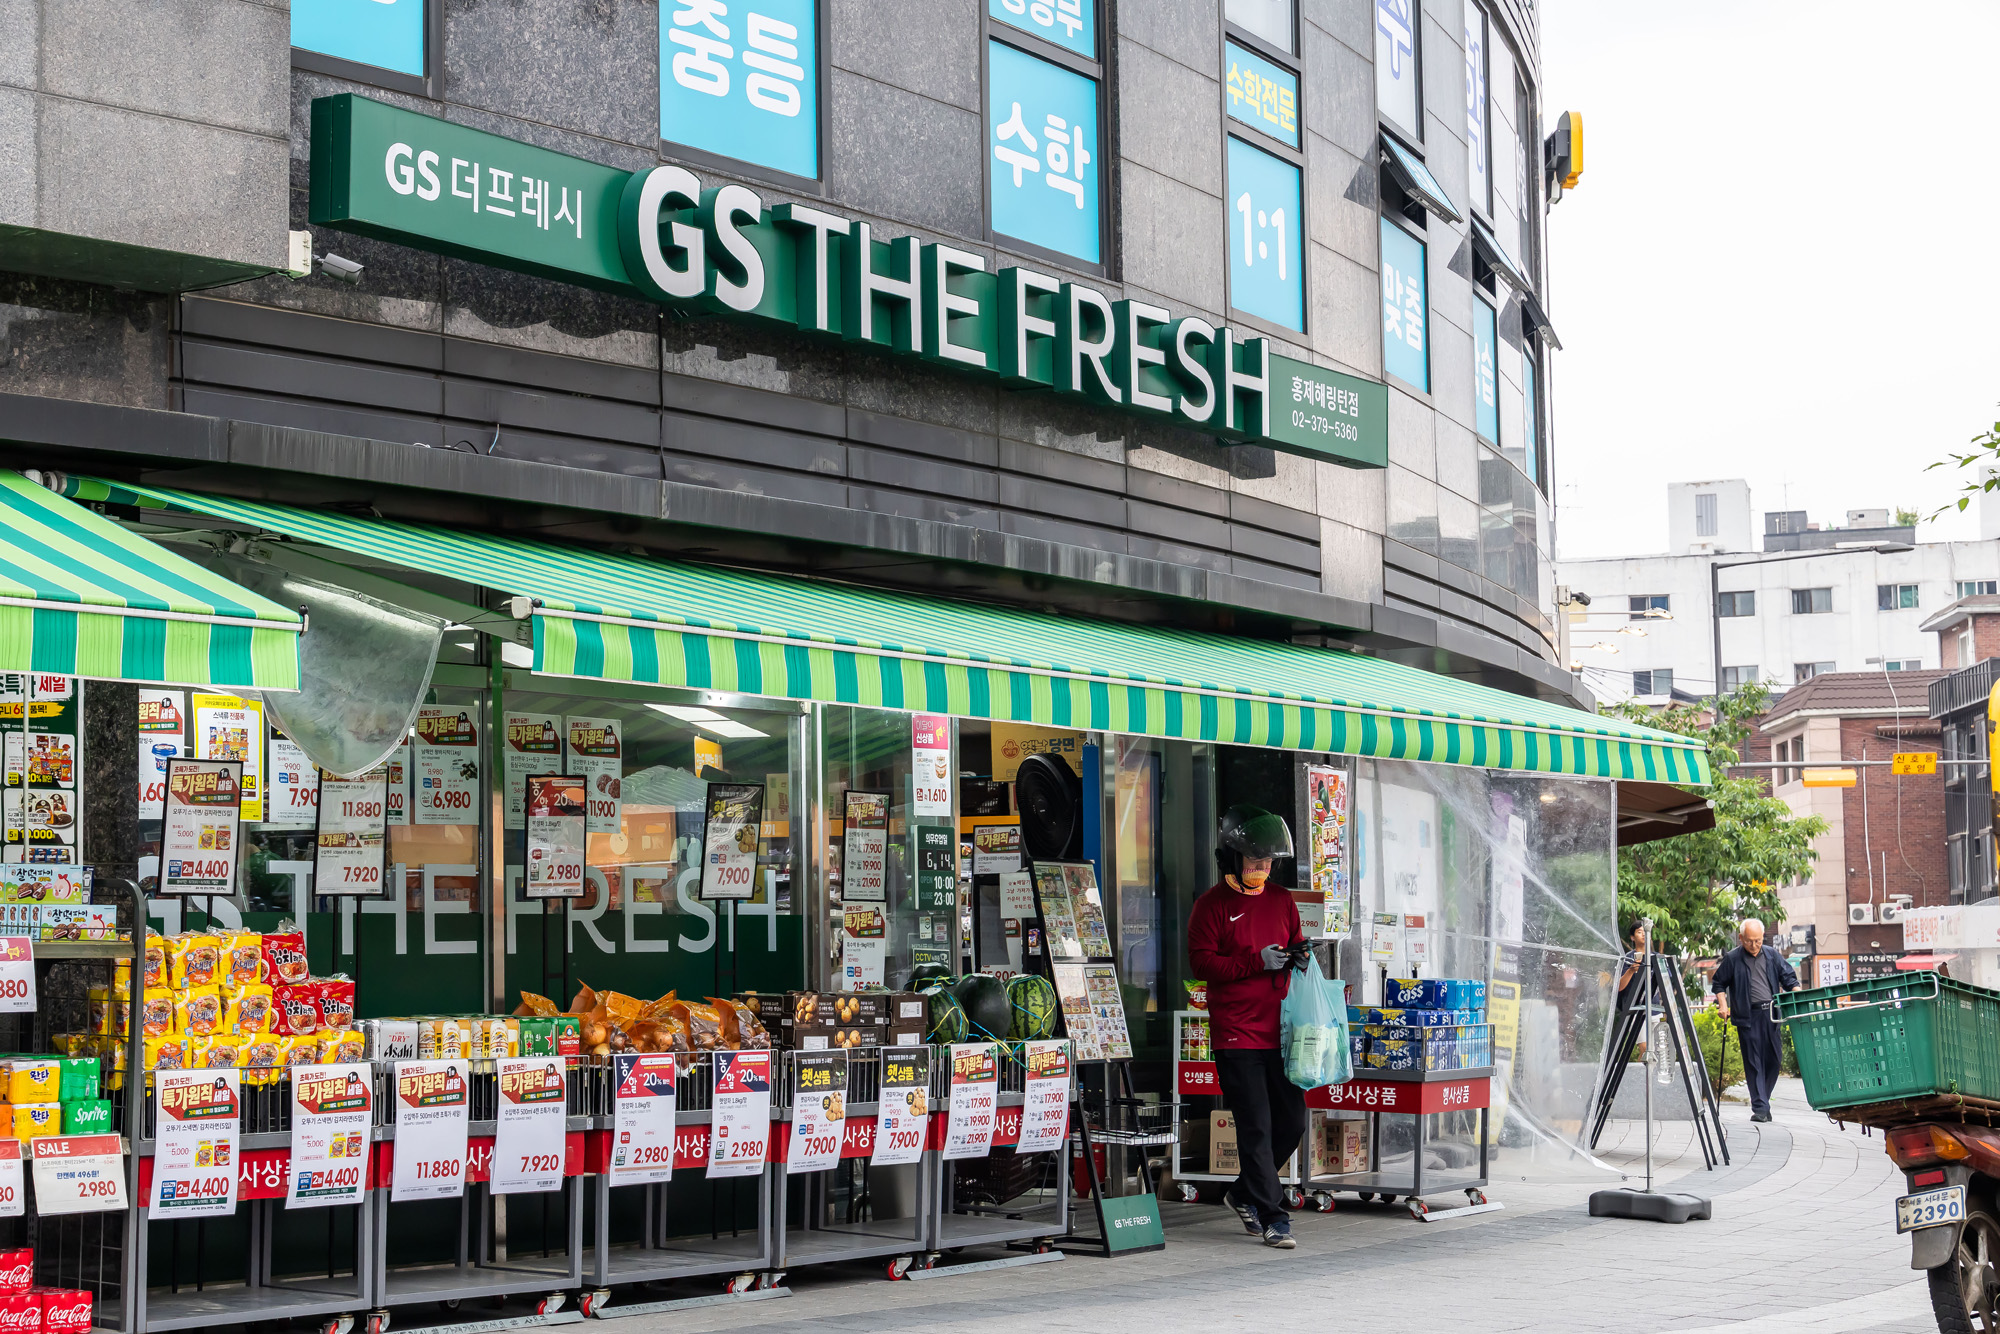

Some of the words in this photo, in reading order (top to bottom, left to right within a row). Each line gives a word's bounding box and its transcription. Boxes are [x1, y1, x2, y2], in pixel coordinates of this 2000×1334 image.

[669, 0, 804, 117] 중등
[1226, 61, 1295, 133] 수학전문
[994, 101, 1090, 210] 수학
[384, 142, 441, 201] GS
[451, 156, 583, 239] 더프레시
[1237, 192, 1287, 281] 1:1
[637, 164, 766, 312] GS
[791, 203, 987, 368] THE
[1016, 266, 1270, 437] FRESH
[1383, 262, 1424, 352] 맞춤
[1291, 375, 1359, 418] 홍제해링턴점
[1292, 409, 1358, 442] 02-379-5360
[39, 675, 66, 692] 세일
[418, 716, 458, 737] 특가원칙
[508, 725, 543, 744] 특가원칙
[570, 730, 604, 748] 특가원칙
[916, 733, 934, 744] 신상품
[1049, 738, 1075, 753] 당면
[171, 773, 218, 796] 특가원칙
[217, 779, 233, 791] 세일
[433, 791, 470, 809] 6,980
[928, 788, 947, 803] 1,610
[589, 800, 616, 818] 11,900
[925, 833, 948, 846] 의무휴업일
[976, 832, 1009, 848] 특가원칙
[17, 868, 53, 882] 찰떡파이
[195, 860, 229, 878] 4,400
[717, 867, 750, 885] 7,900
[934, 876, 954, 890] 10:00
[267, 860, 477, 955] THE
[506, 864, 777, 955] FRESH
[934, 892, 955, 906] 23:00
[52, 909, 88, 922] 찰떡파이
[845, 911, 874, 930] 특가원칙
[232, 959, 258, 973] 스낵면
[270, 950, 303, 965] 김치라면
[915, 953, 932, 962] CCTV
[187, 960, 212, 975] 스낵면
[1822, 962, 1844, 973] 엄마
[189, 1009, 214, 1023] 스낵면
[239, 1007, 264, 1021] 스낵면
[281, 1000, 313, 1016] 김치라면
[320, 999, 351, 1015] 김치라면
[384, 1043, 413, 1059] Asahi
[955, 1054, 983, 1075] 특가원칙
[1029, 1050, 1056, 1071] 특가원칙
[30, 1069, 50, 1080] 환타
[801, 1067, 831, 1088] 햇상품
[886, 1063, 914, 1084] 햇상품
[1184, 1071, 1214, 1084] 인생을
[298, 1077, 346, 1104] 특가원칙
[347, 1082, 364, 1096] 세일
[399, 1071, 446, 1099] 특가원칙
[446, 1078, 461, 1090] 세일
[502, 1070, 545, 1098] 특가원칙
[545, 1075, 559, 1087] 세일
[162, 1083, 213, 1111] 특가원칙
[213, 1089, 230, 1103] 세일
[970, 1097, 991, 1109] 17,900
[1044, 1092, 1064, 1104] 17,900
[1328, 1083, 1397, 1106] 행사상품
[1442, 1085, 1470, 1106] 행사상품
[31, 1110, 50, 1121] 환타
[75, 1106, 108, 1125] Sprite
[970, 1115, 990, 1127] 19,900
[1043, 1109, 1063, 1121] 19,900
[889, 1131, 919, 1150] 7,900
[966, 1132, 987, 1144] 21,900
[1040, 1127, 1060, 1139] 21,900
[38, 1142, 71, 1155] SALE
[804, 1136, 837, 1157] 7,900
[416, 1159, 460, 1179] 11,880
[521, 1154, 559, 1173] 7,920
[77, 1170, 100, 1179] 496원!
[325, 1167, 359, 1187] 4,400
[191, 1177, 229, 1198] 4,400
[1924, 1192, 1949, 1203] 서대문
[1913, 1201, 1959, 1224] 2390
[1114, 1218, 1122, 1229] GS
[1122, 1217, 1133, 1228] THE
[1133, 1215, 1152, 1226] FRESH
[47, 1303, 93, 1324] Coca-Cola
